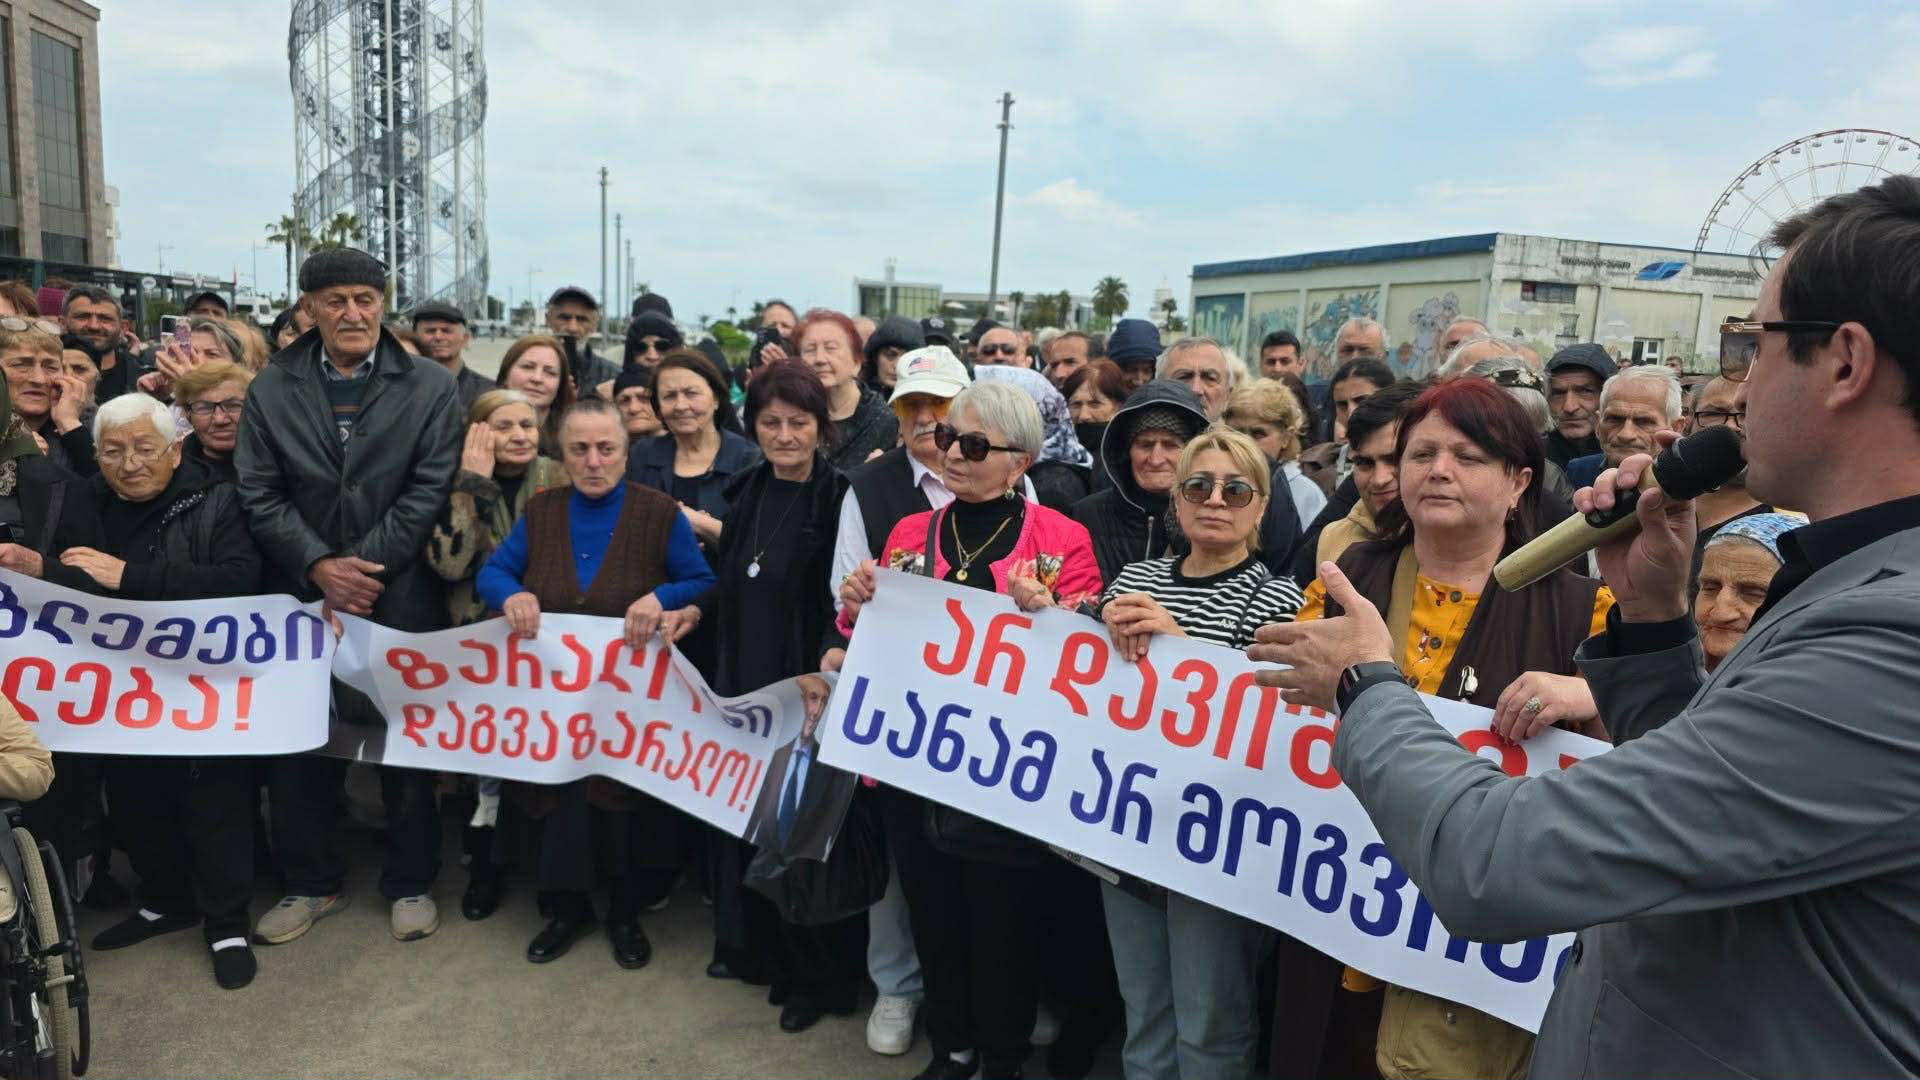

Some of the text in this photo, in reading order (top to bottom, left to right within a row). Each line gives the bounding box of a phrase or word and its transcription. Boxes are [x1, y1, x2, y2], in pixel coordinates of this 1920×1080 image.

[923, 598, 1032, 695] არ
[402, 700, 763, 813] დაგვაზარალო!
[842, 676, 1058, 803] სანამ
[1069, 748, 1158, 845] არ
